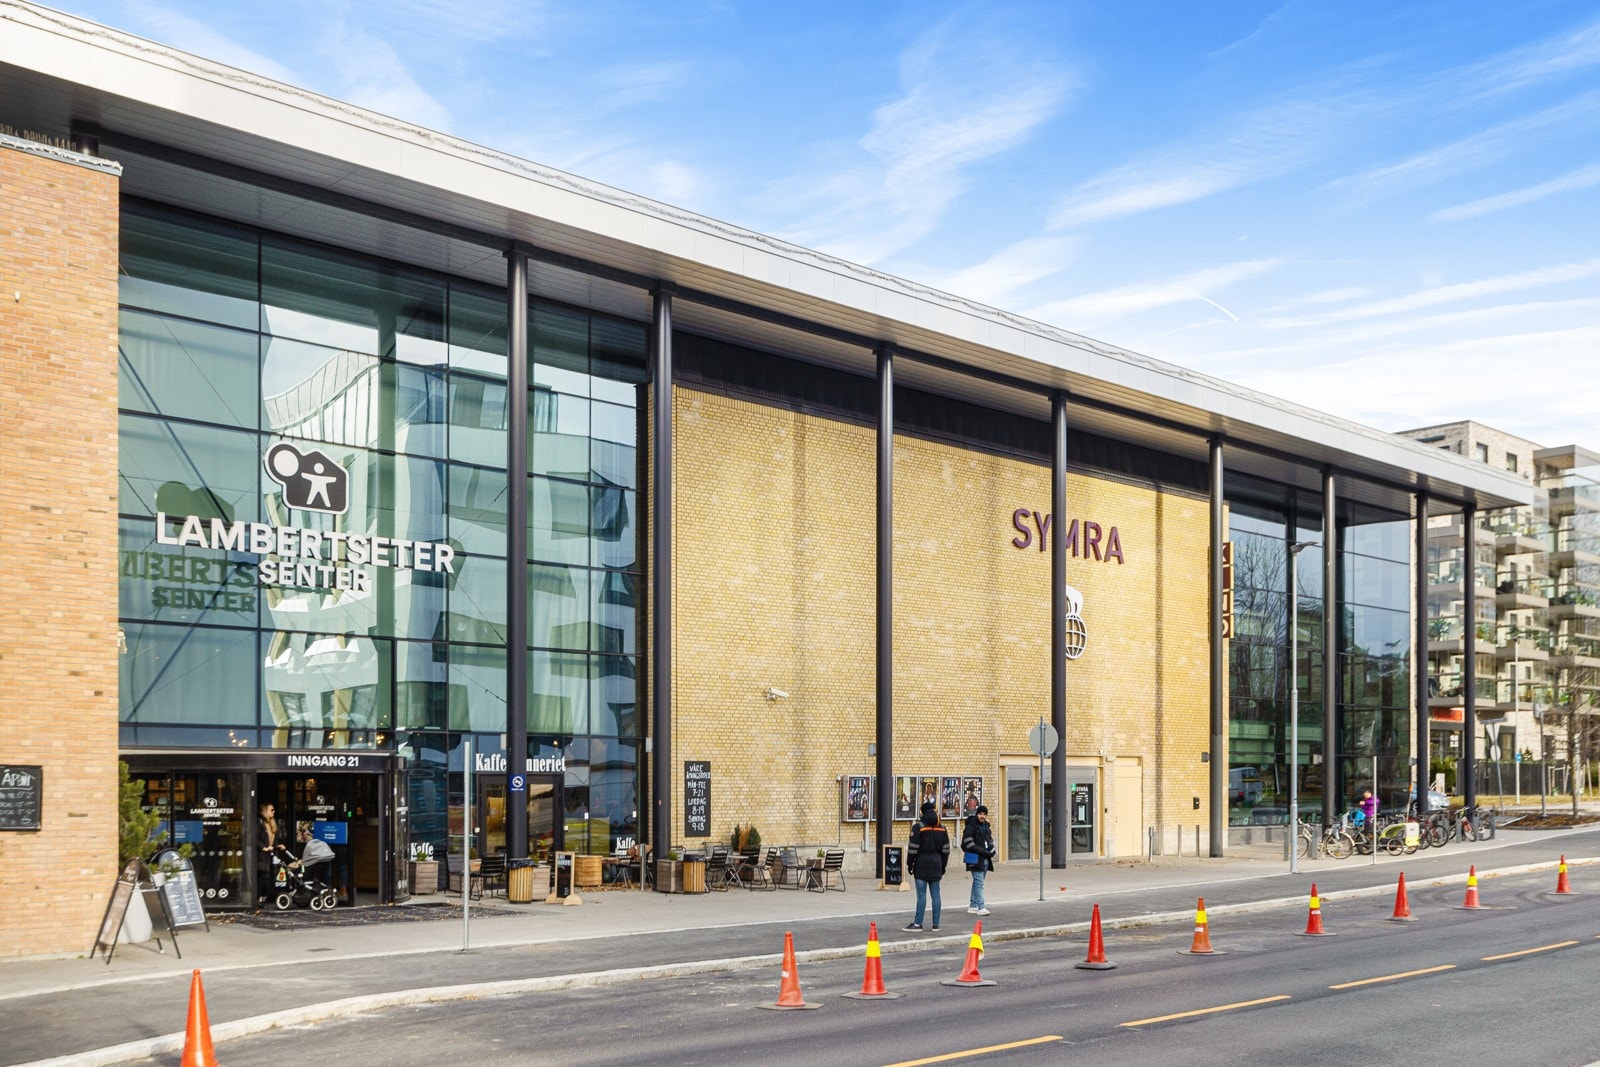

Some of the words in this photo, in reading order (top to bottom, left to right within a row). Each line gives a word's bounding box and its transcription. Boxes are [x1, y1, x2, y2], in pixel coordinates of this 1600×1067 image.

[156, 511, 454, 574] LAMBERTSETER
[259, 559, 369, 592] SENTER
[287, 755, 346, 767] INNGANG
[347, 755, 359, 767] 21
[475, 753, 567, 772] Kaffenneriet
[410, 842, 434, 856] Kaffe
[616, 836, 636, 849] Kaffe
